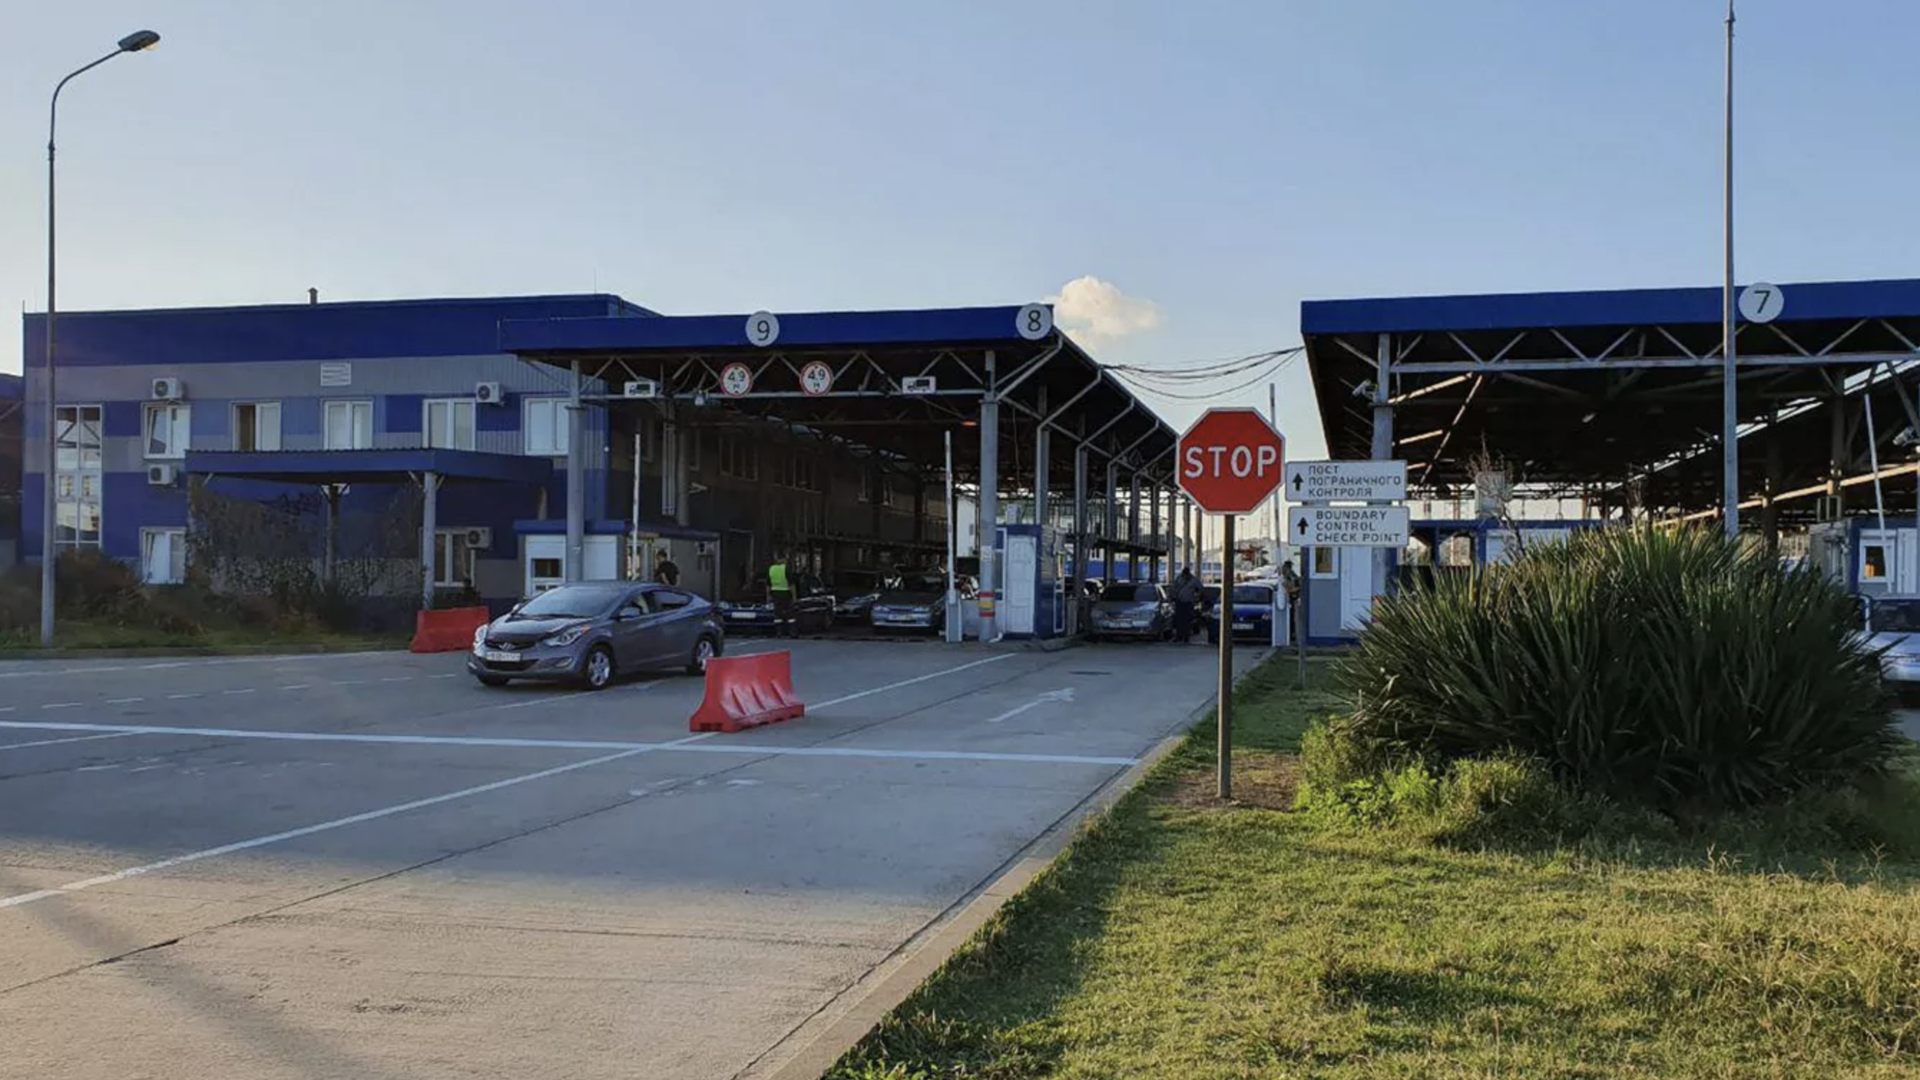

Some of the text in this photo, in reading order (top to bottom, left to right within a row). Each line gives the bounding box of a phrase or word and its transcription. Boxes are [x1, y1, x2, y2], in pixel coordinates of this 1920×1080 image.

[1754, 290, 1771, 314] 7
[1028, 310, 1041, 332] 8
[757, 320, 770, 341] 9
[1184, 445, 1277, 478] STOP
[1308, 465, 1340, 475] ПОСТ
[1308, 475, 1401, 486] ПОГРАНИЧНОГО
[1308, 487, 1372, 497] КОНТРОЛЯ
[1316, 510, 1387, 520] BOUNDARY
[1316, 521, 1376, 532] CONTROL
[1316, 532, 1401, 542] CHECK POINT
